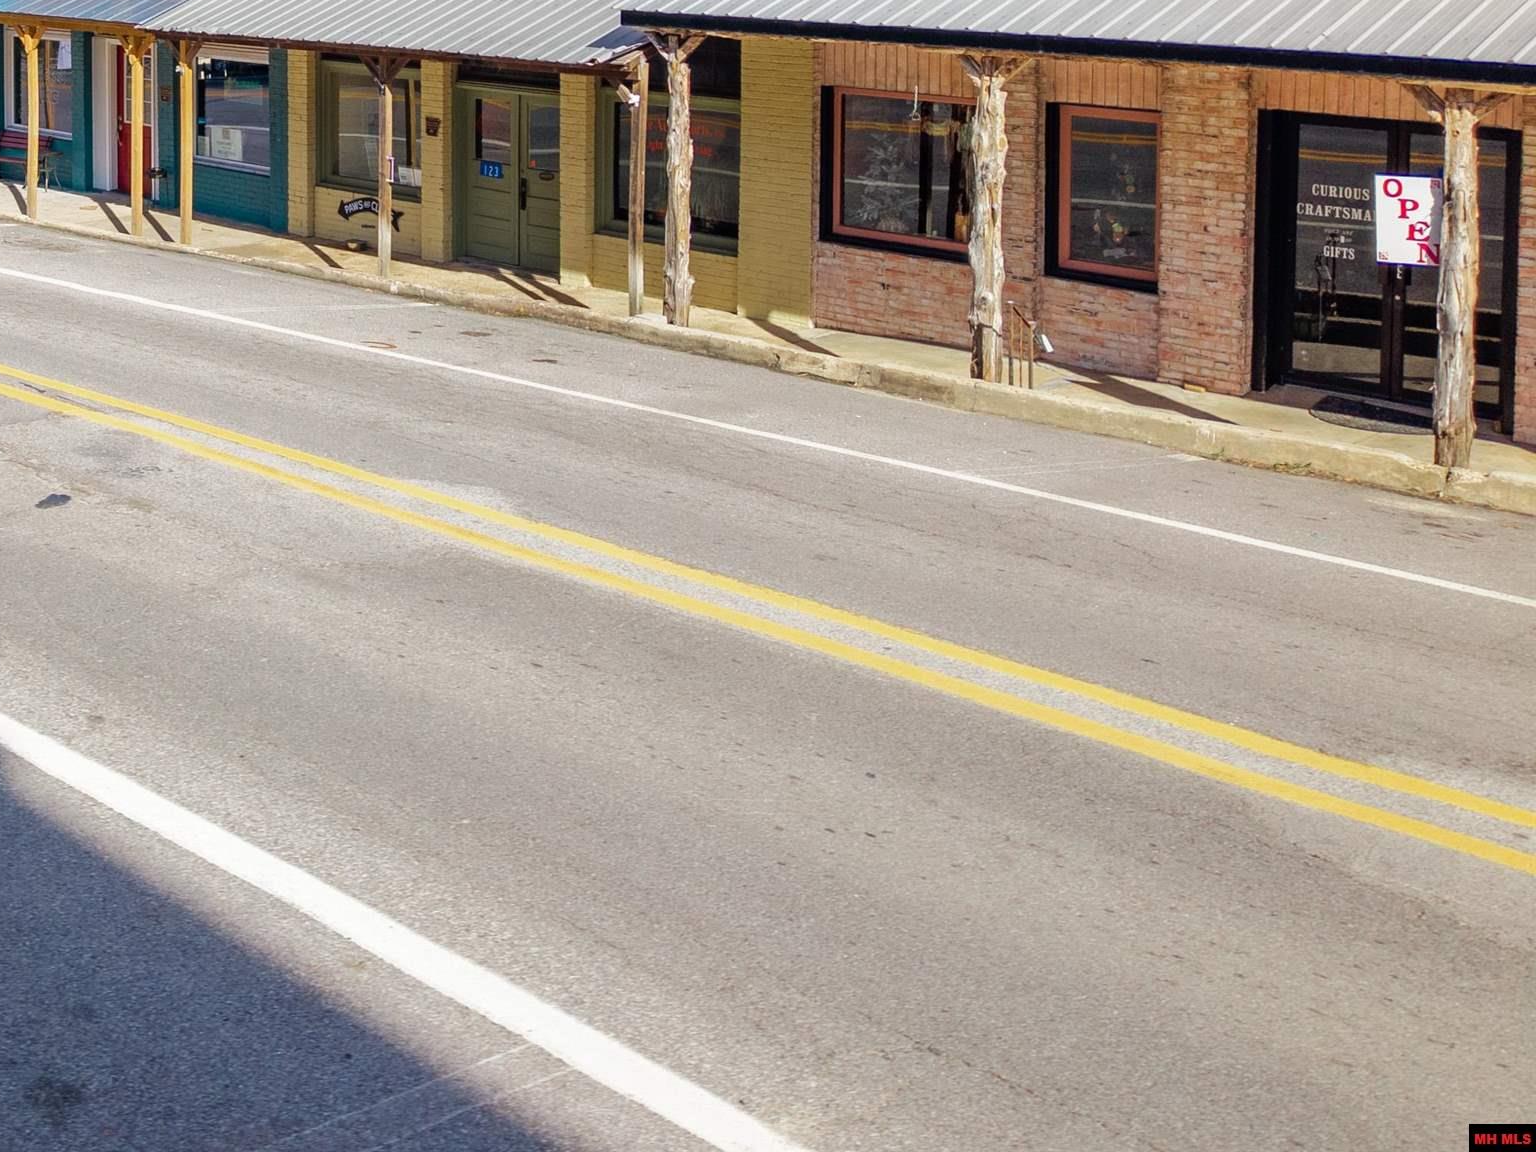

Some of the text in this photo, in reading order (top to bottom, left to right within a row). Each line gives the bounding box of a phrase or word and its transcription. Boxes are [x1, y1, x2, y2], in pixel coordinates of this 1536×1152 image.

[484, 165, 499, 177] 123
[1312, 184, 1370, 201] CURIOUS
[344, 200, 364, 214] PAWS
[1296, 202, 1373, 222] CRAFTSMA
[1382, 178, 1441, 265] OPEN
[1323, 245, 1356, 260] GIFTS
